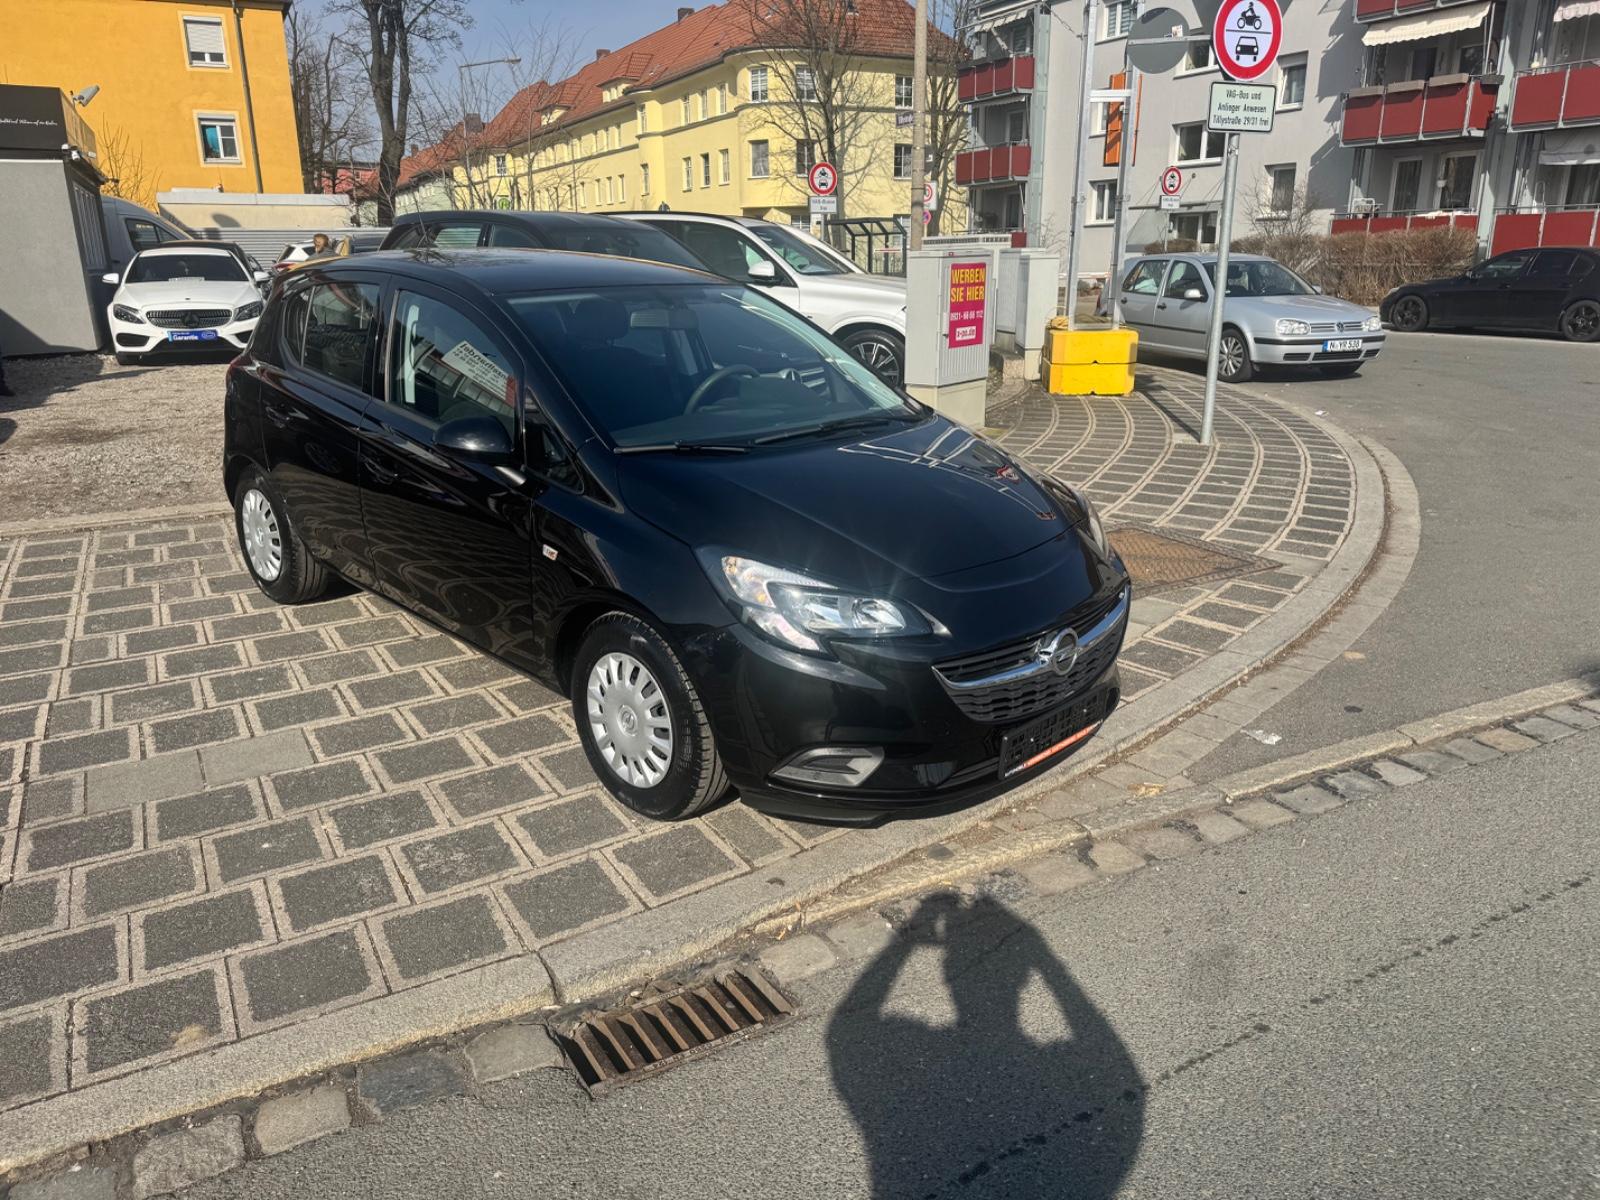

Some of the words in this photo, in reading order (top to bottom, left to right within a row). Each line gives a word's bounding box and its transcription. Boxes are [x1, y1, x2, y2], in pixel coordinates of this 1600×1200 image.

[1226, 89, 1249, 99] VAG-Bus
[1251, 92, 1262, 100] und
[951, 267, 986, 284] WERBEN
[950, 287, 964, 303] SIE
[966, 286, 985, 302] HIER
